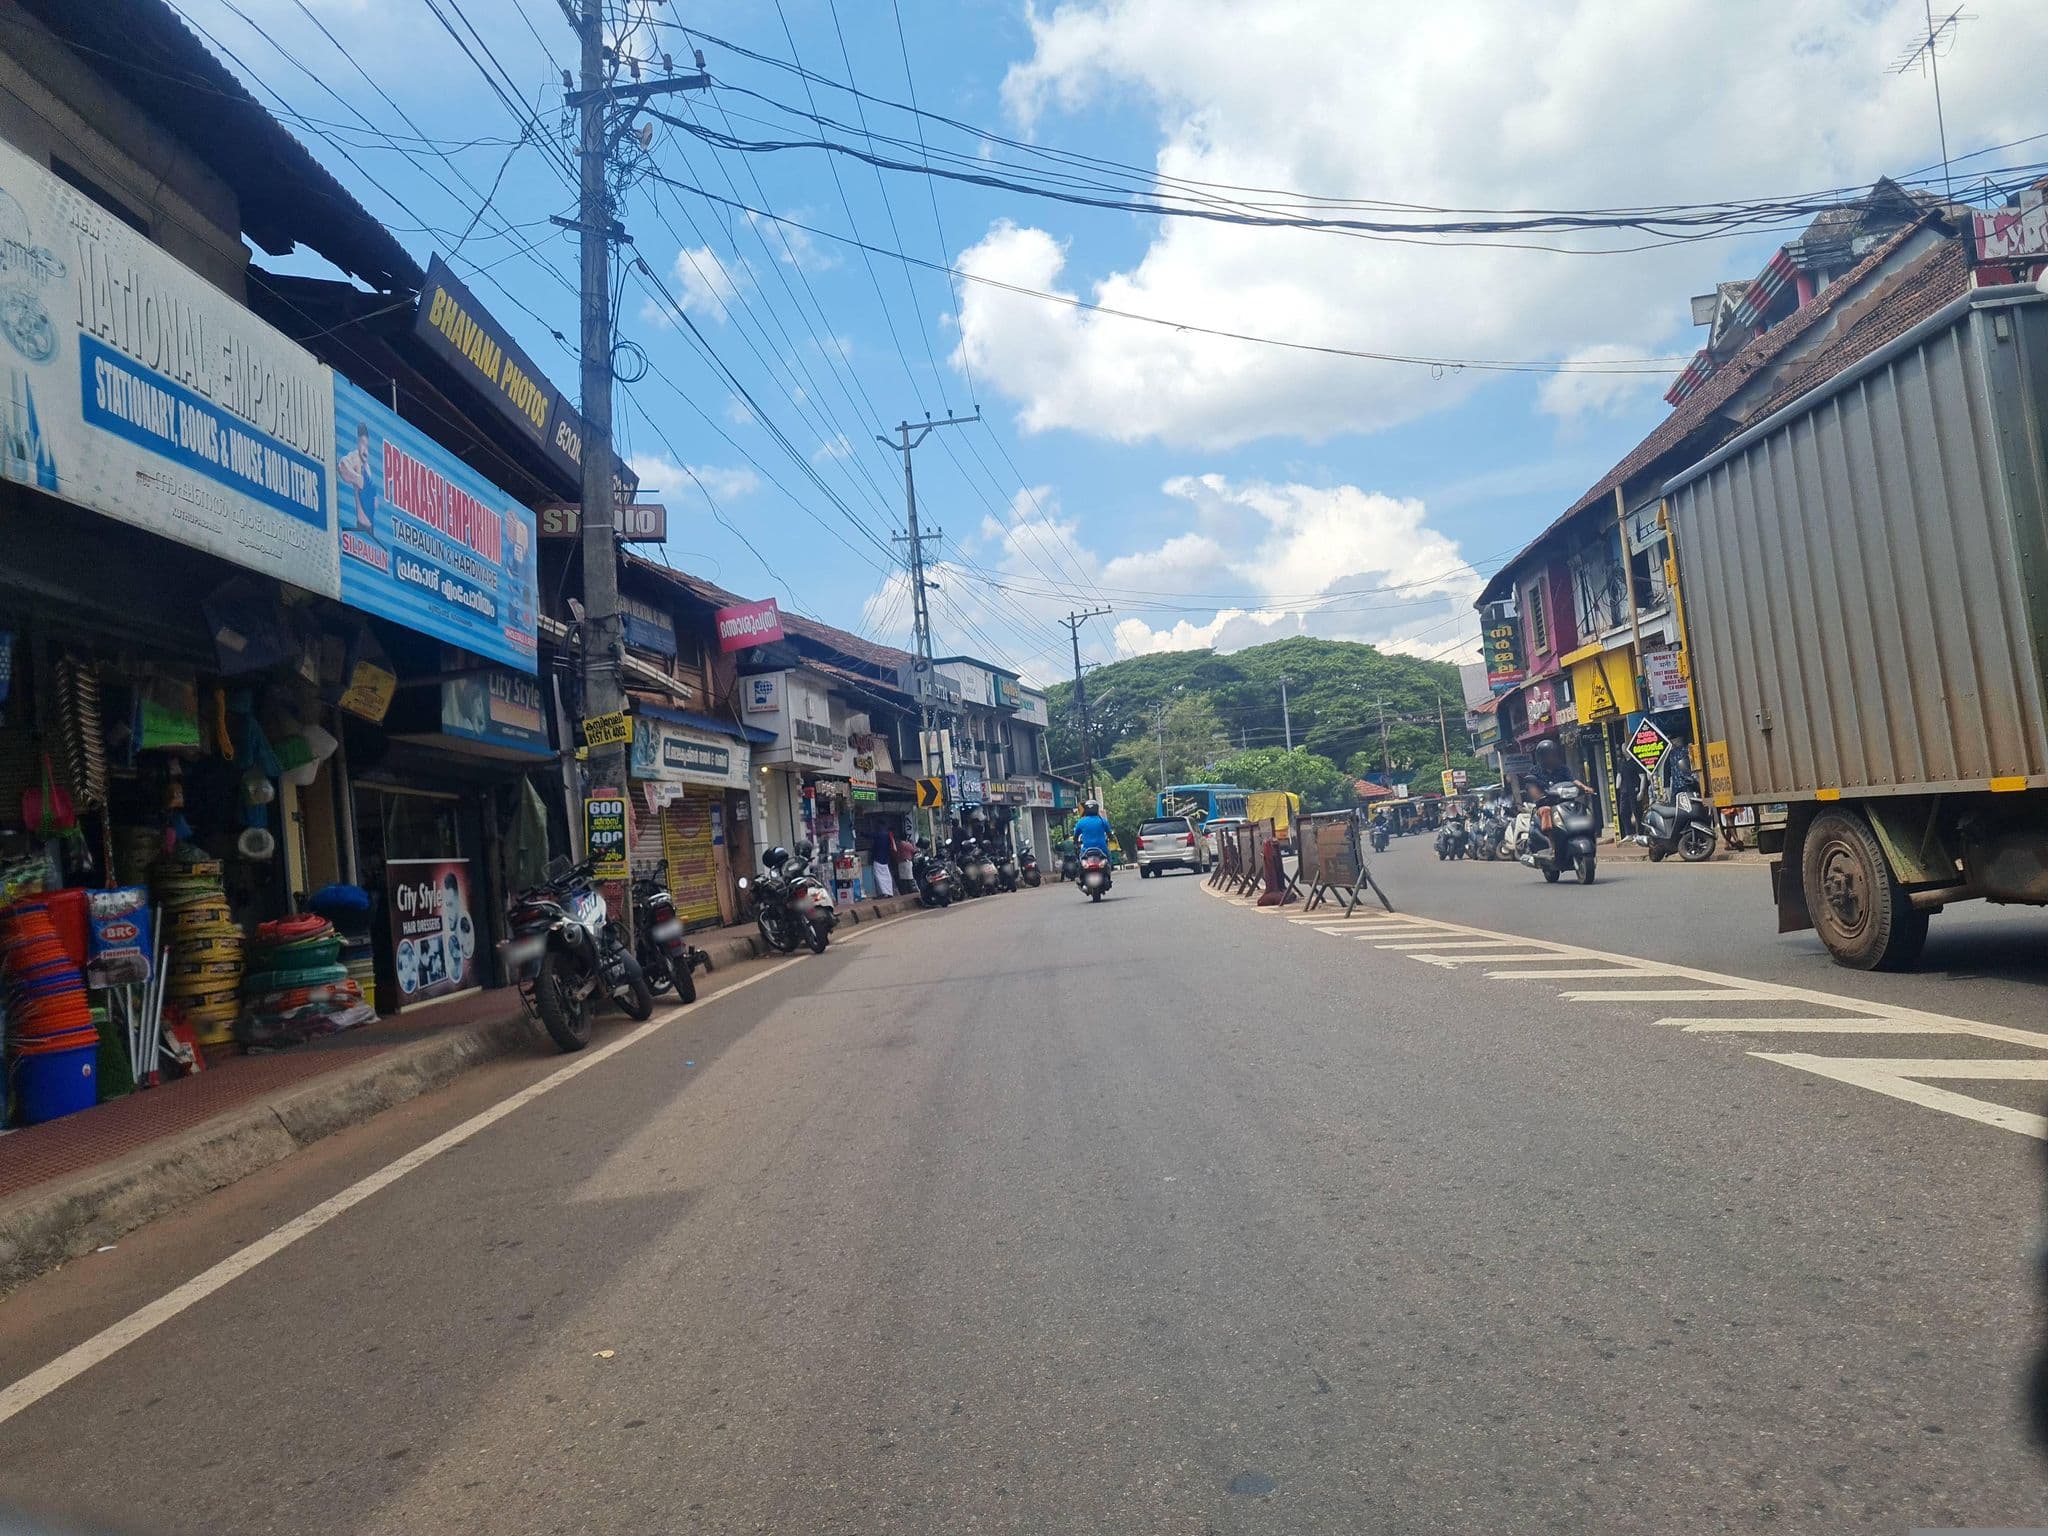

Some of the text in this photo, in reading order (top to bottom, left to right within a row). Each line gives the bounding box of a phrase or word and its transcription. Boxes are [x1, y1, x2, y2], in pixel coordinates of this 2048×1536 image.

[76, 236, 326, 462] NATIONAL EMPORIUM
[428, 286, 549, 429] BHAVANA PHOTOS
[95, 356, 320, 513] STATIONARY, BOOKS & HOUSE HOLD ITEMS
[383, 438, 502, 566] PRAKASH EMPORIUM
[543, 508, 656, 534] STDIO
[391, 517, 445, 562] TARPAULIN
[453, 550, 497, 590] HARDWARE
[513, 676, 540, 711] Style
[589, 801, 623, 815] 600
[396, 881, 443, 917] City Style
[106, 926, 135, 939] BRC
[402, 921, 417, 935] HAIR
